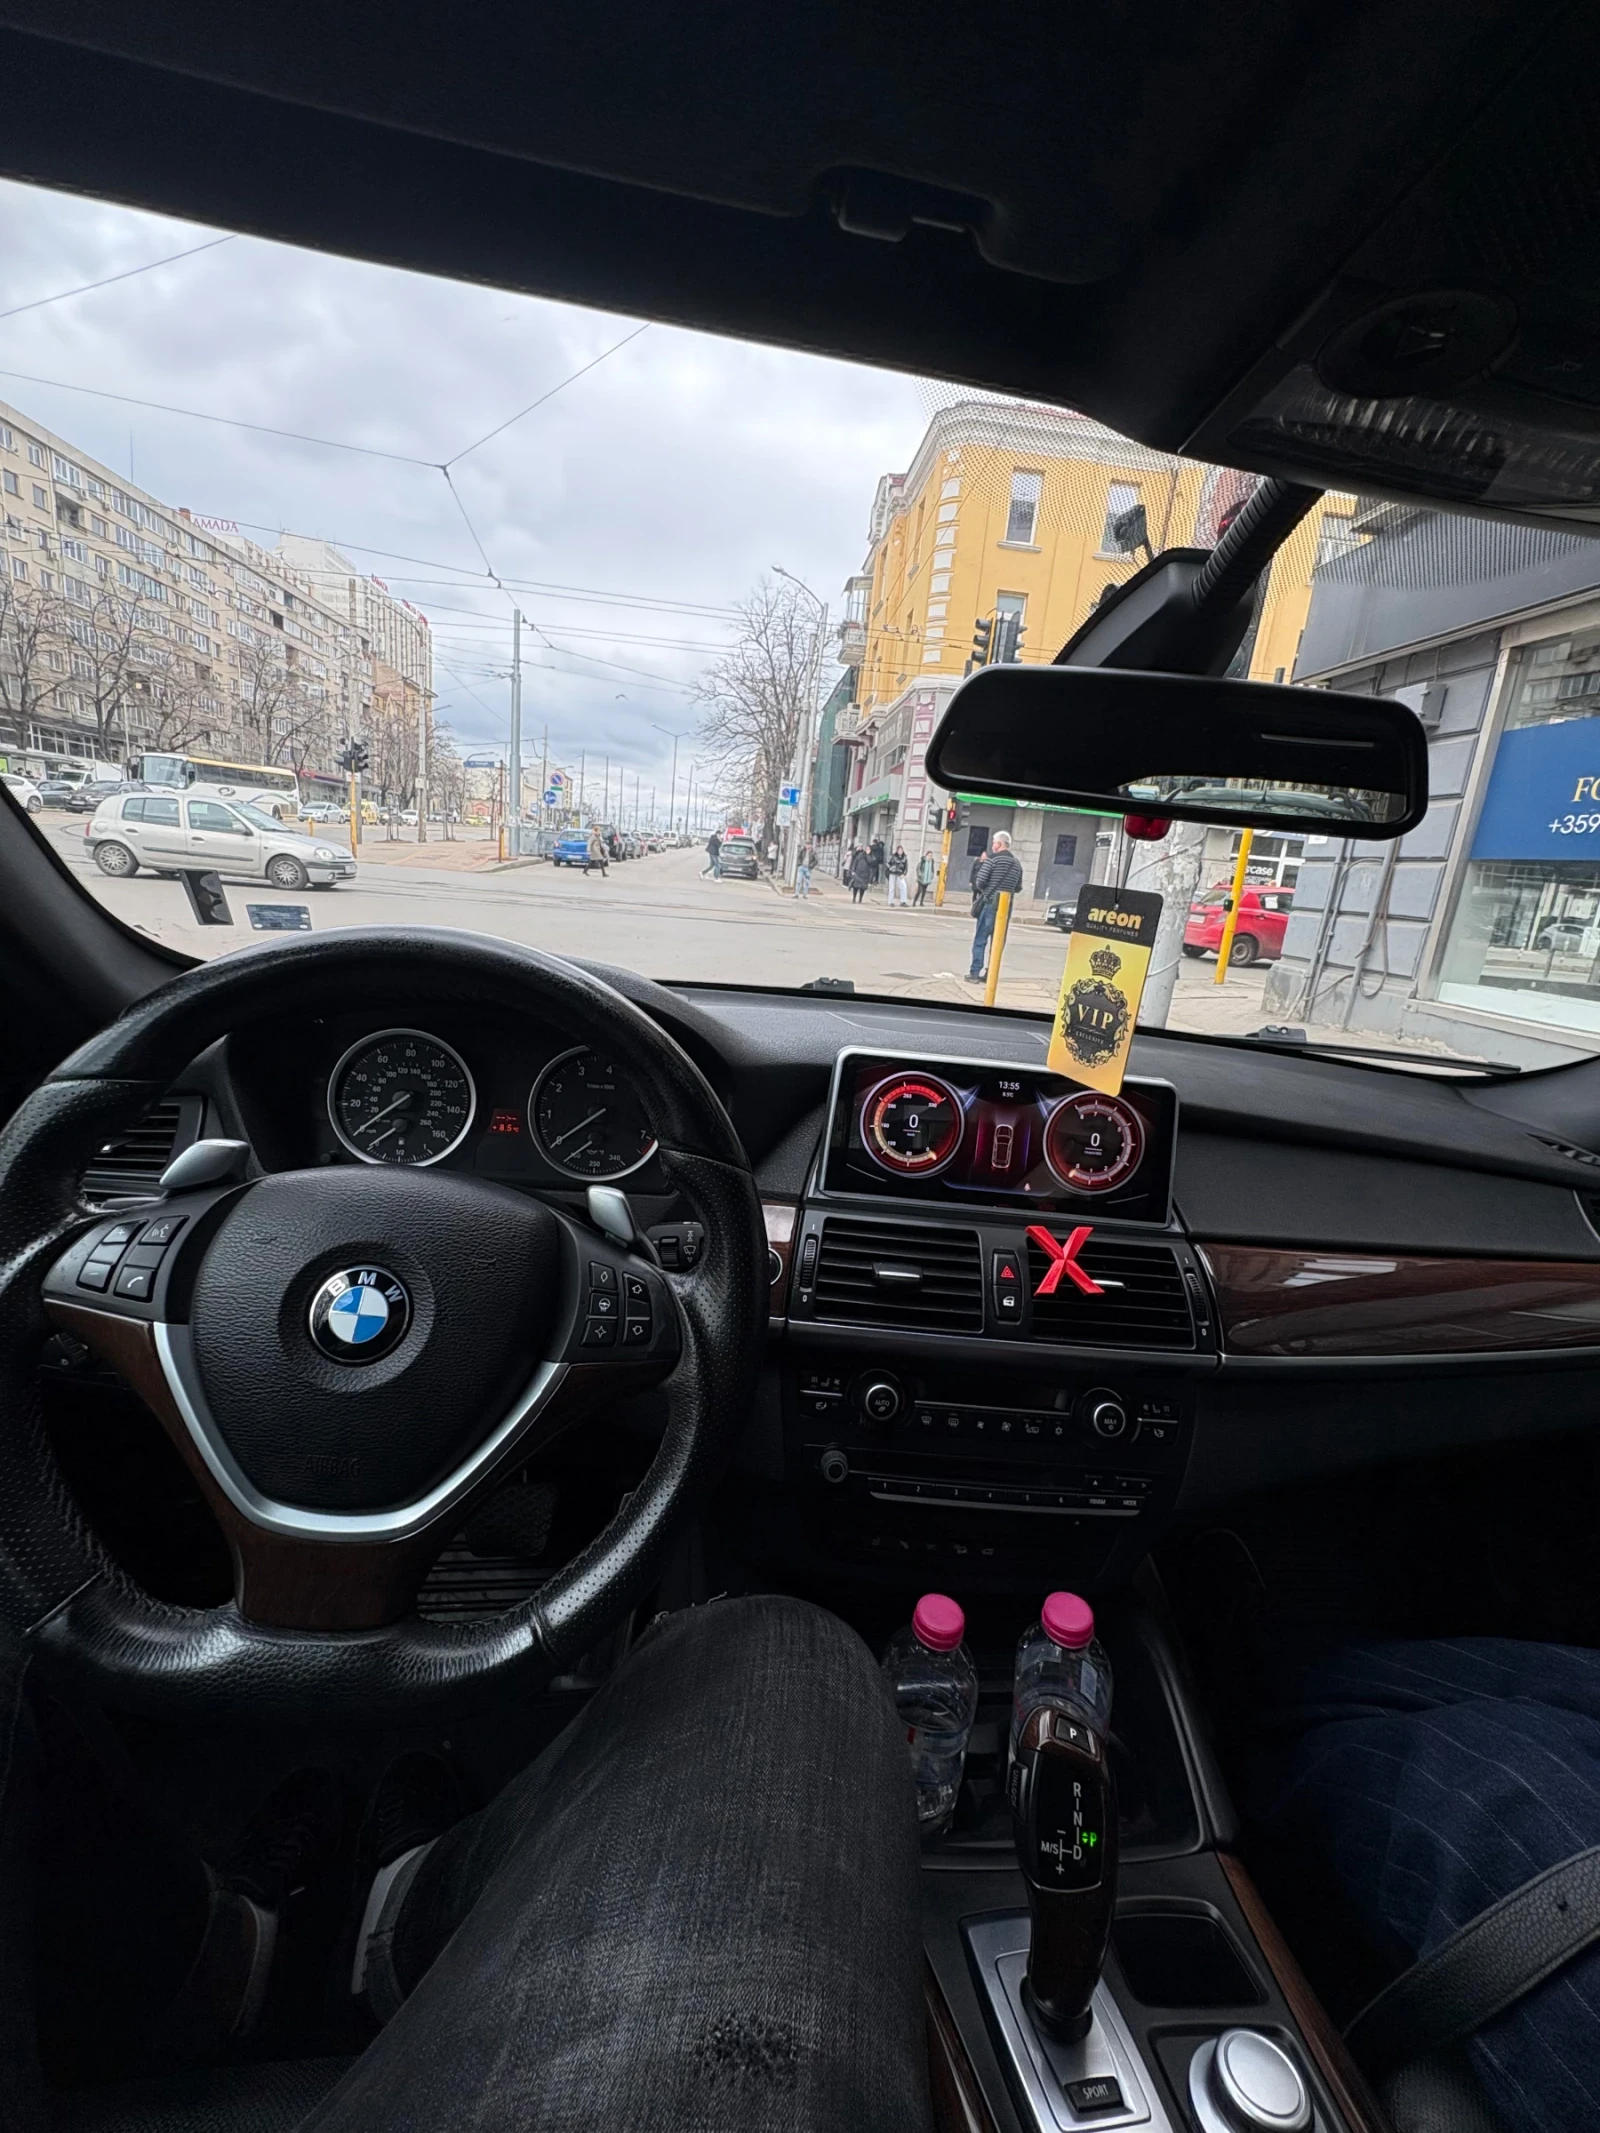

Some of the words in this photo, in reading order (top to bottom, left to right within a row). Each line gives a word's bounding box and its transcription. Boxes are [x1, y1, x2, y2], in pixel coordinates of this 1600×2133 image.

[1548, 814, 1600, 834] +359
[1088, 908, 1142, 930] areon
[1086, 922, 1108, 931] QUALITY
[1109, 927, 1138, 937] PERFUMES
[1078, 1004, 1113, 1029] VIP
[378, 1055, 388, 1063] 60
[406, 1049, 416, 1057] 80
[431, 1060, 445, 1068] 100
[579, 1066, 585, 1076] 3
[606, 1065, 612, 1074] 4
[356, 1074, 367, 1082] 40
[556, 1083, 562, 1093] 2
[999, 1081, 1020, 1090] 13:55
[350, 1099, 361, 1107] 20
[446, 1106, 460, 1114] 140
[547, 1110, 552, 1119] 1
[909, 1114, 918, 1128] 0
[432, 1130, 446, 1139] 160
[640, 1130, 646, 1139] 7
[1090, 1133, 1100, 1147] 0
[327, 1271, 403, 1303] BMW
[301, 1455, 360, 1477] AIRBAG
[1069, 1728, 1077, 1739] P
[1011, 1769, 1020, 1808] UNLOCK
[1073, 1782, 1081, 1798] R
[1074, 1812, 1082, 1827] N
[1089, 1832, 1097, 1847] P
[1041, 1840, 1059, 1855] M/S
[1073, 1846, 1082, 1860] D
[1082, 2084, 1109, 2100] SPORT
